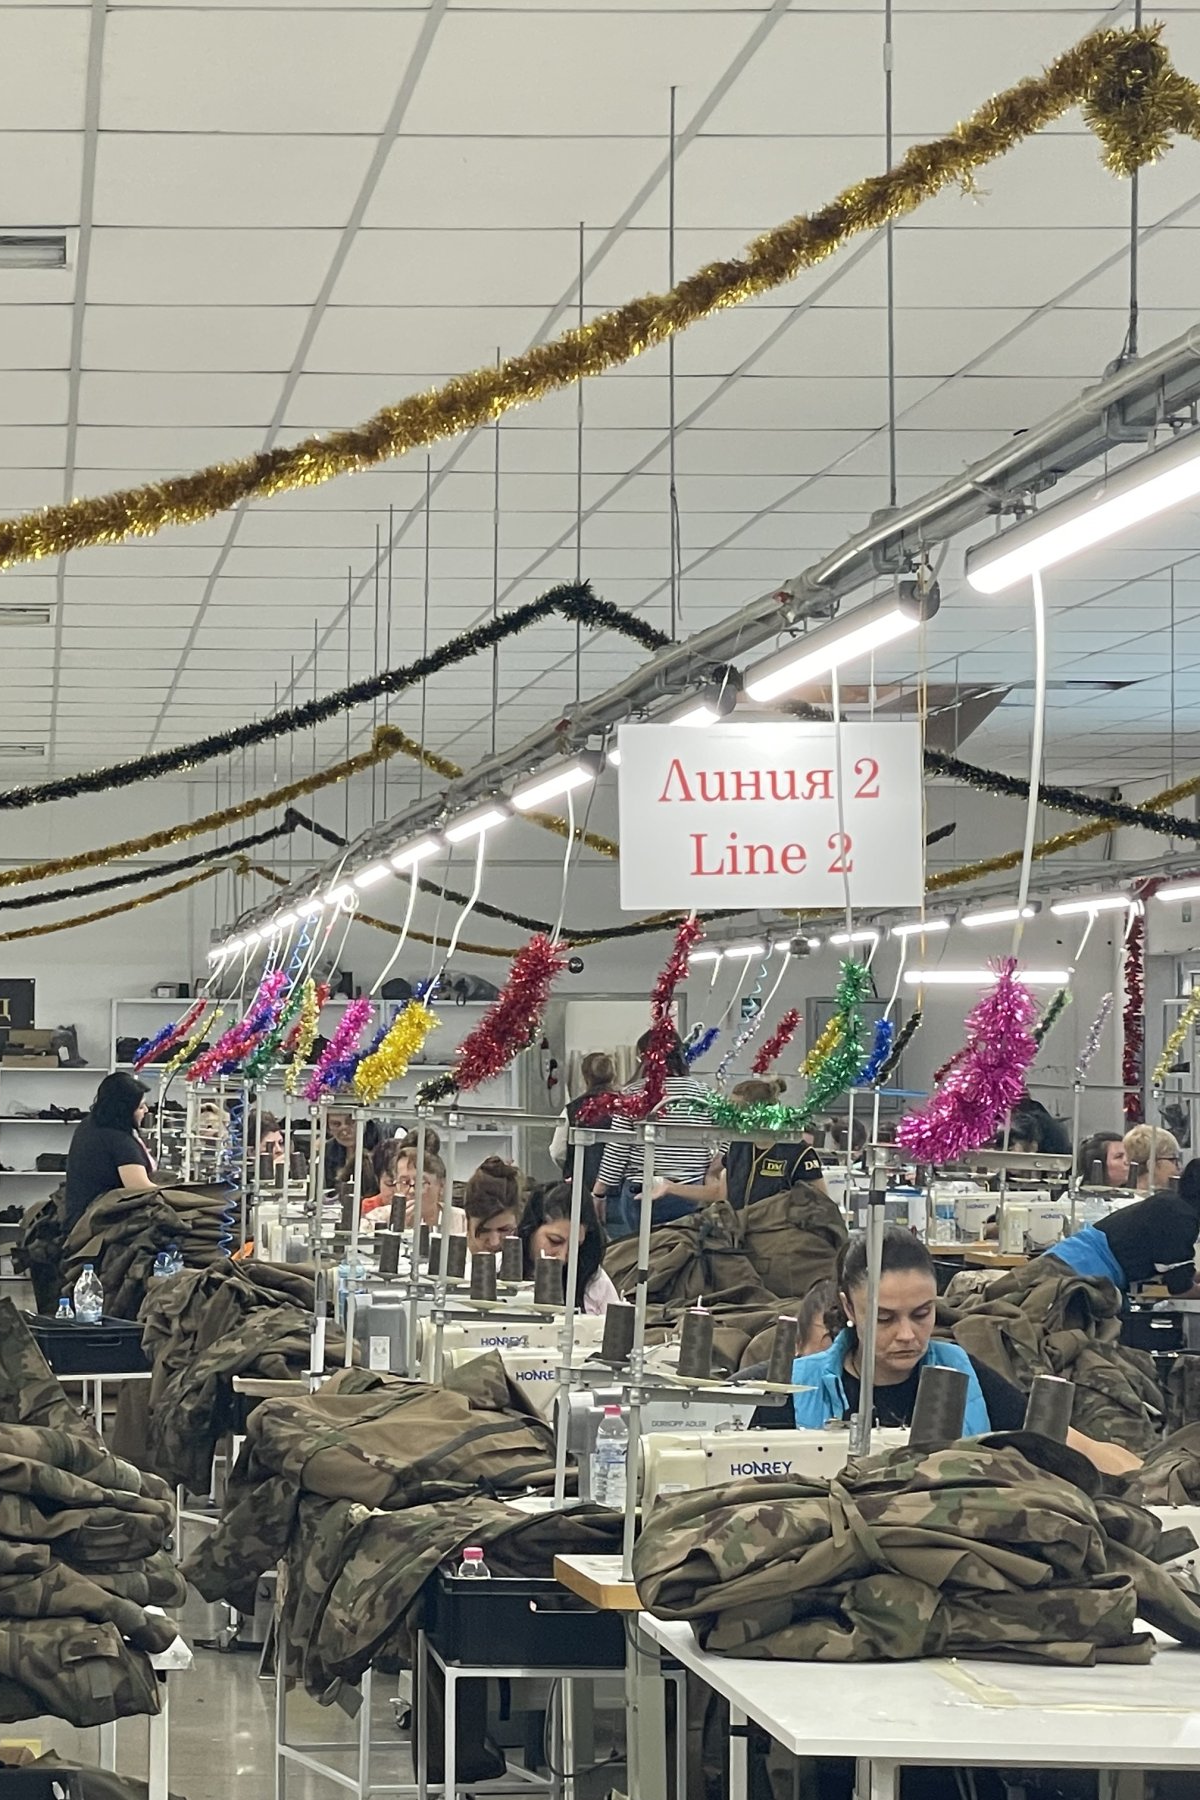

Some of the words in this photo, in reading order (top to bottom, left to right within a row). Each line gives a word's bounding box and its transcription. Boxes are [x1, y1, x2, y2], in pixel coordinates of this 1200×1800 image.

[658, 758, 834, 801] Линия
[853, 757, 880, 798] 2
[690, 832, 807, 876] Line
[827, 832, 853, 873] 2
[516, 1370, 555, 1381] HONRE
[731, 1461, 792, 1476] HONREY
